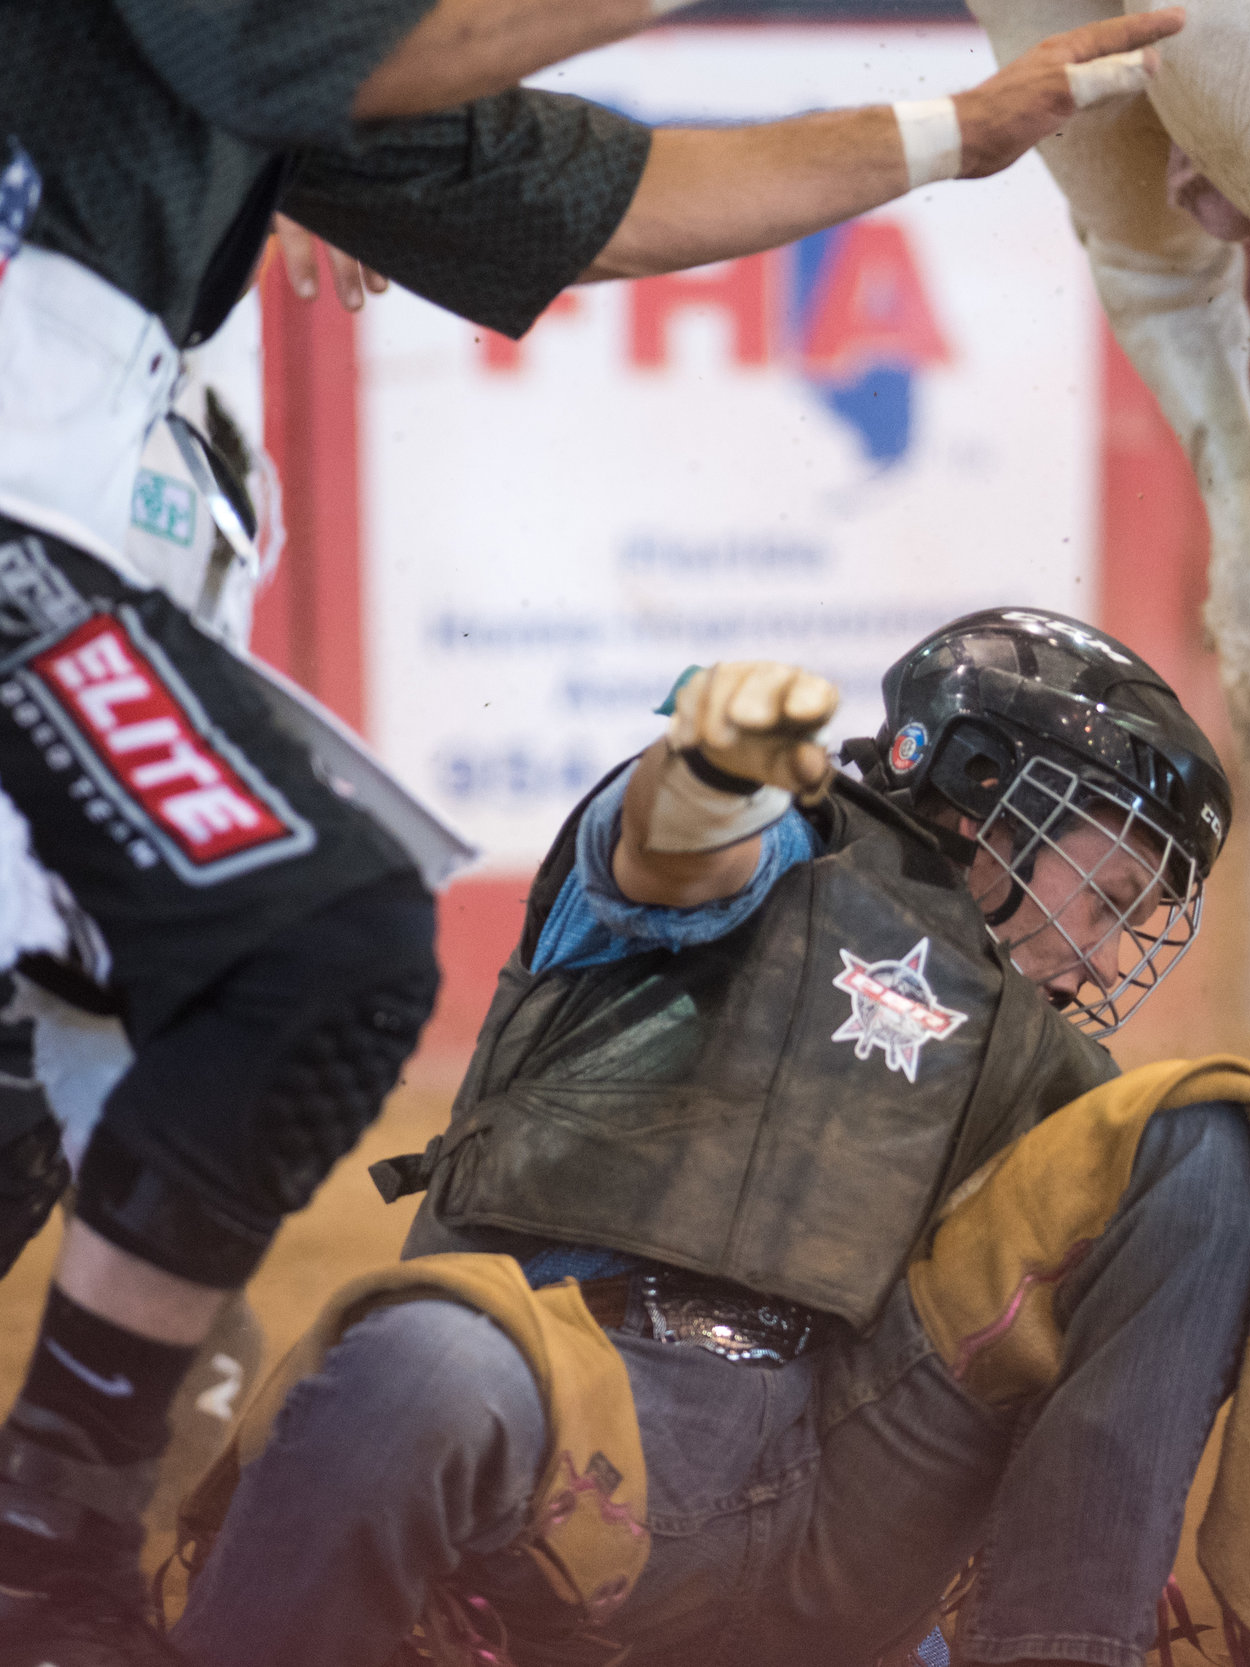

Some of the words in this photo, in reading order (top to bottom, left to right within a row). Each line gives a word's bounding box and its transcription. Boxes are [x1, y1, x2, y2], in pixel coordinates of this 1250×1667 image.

[479, 220, 953, 374] HA
[52, 631, 261, 845] ELITE
[1200, 802, 1222, 842] CC
